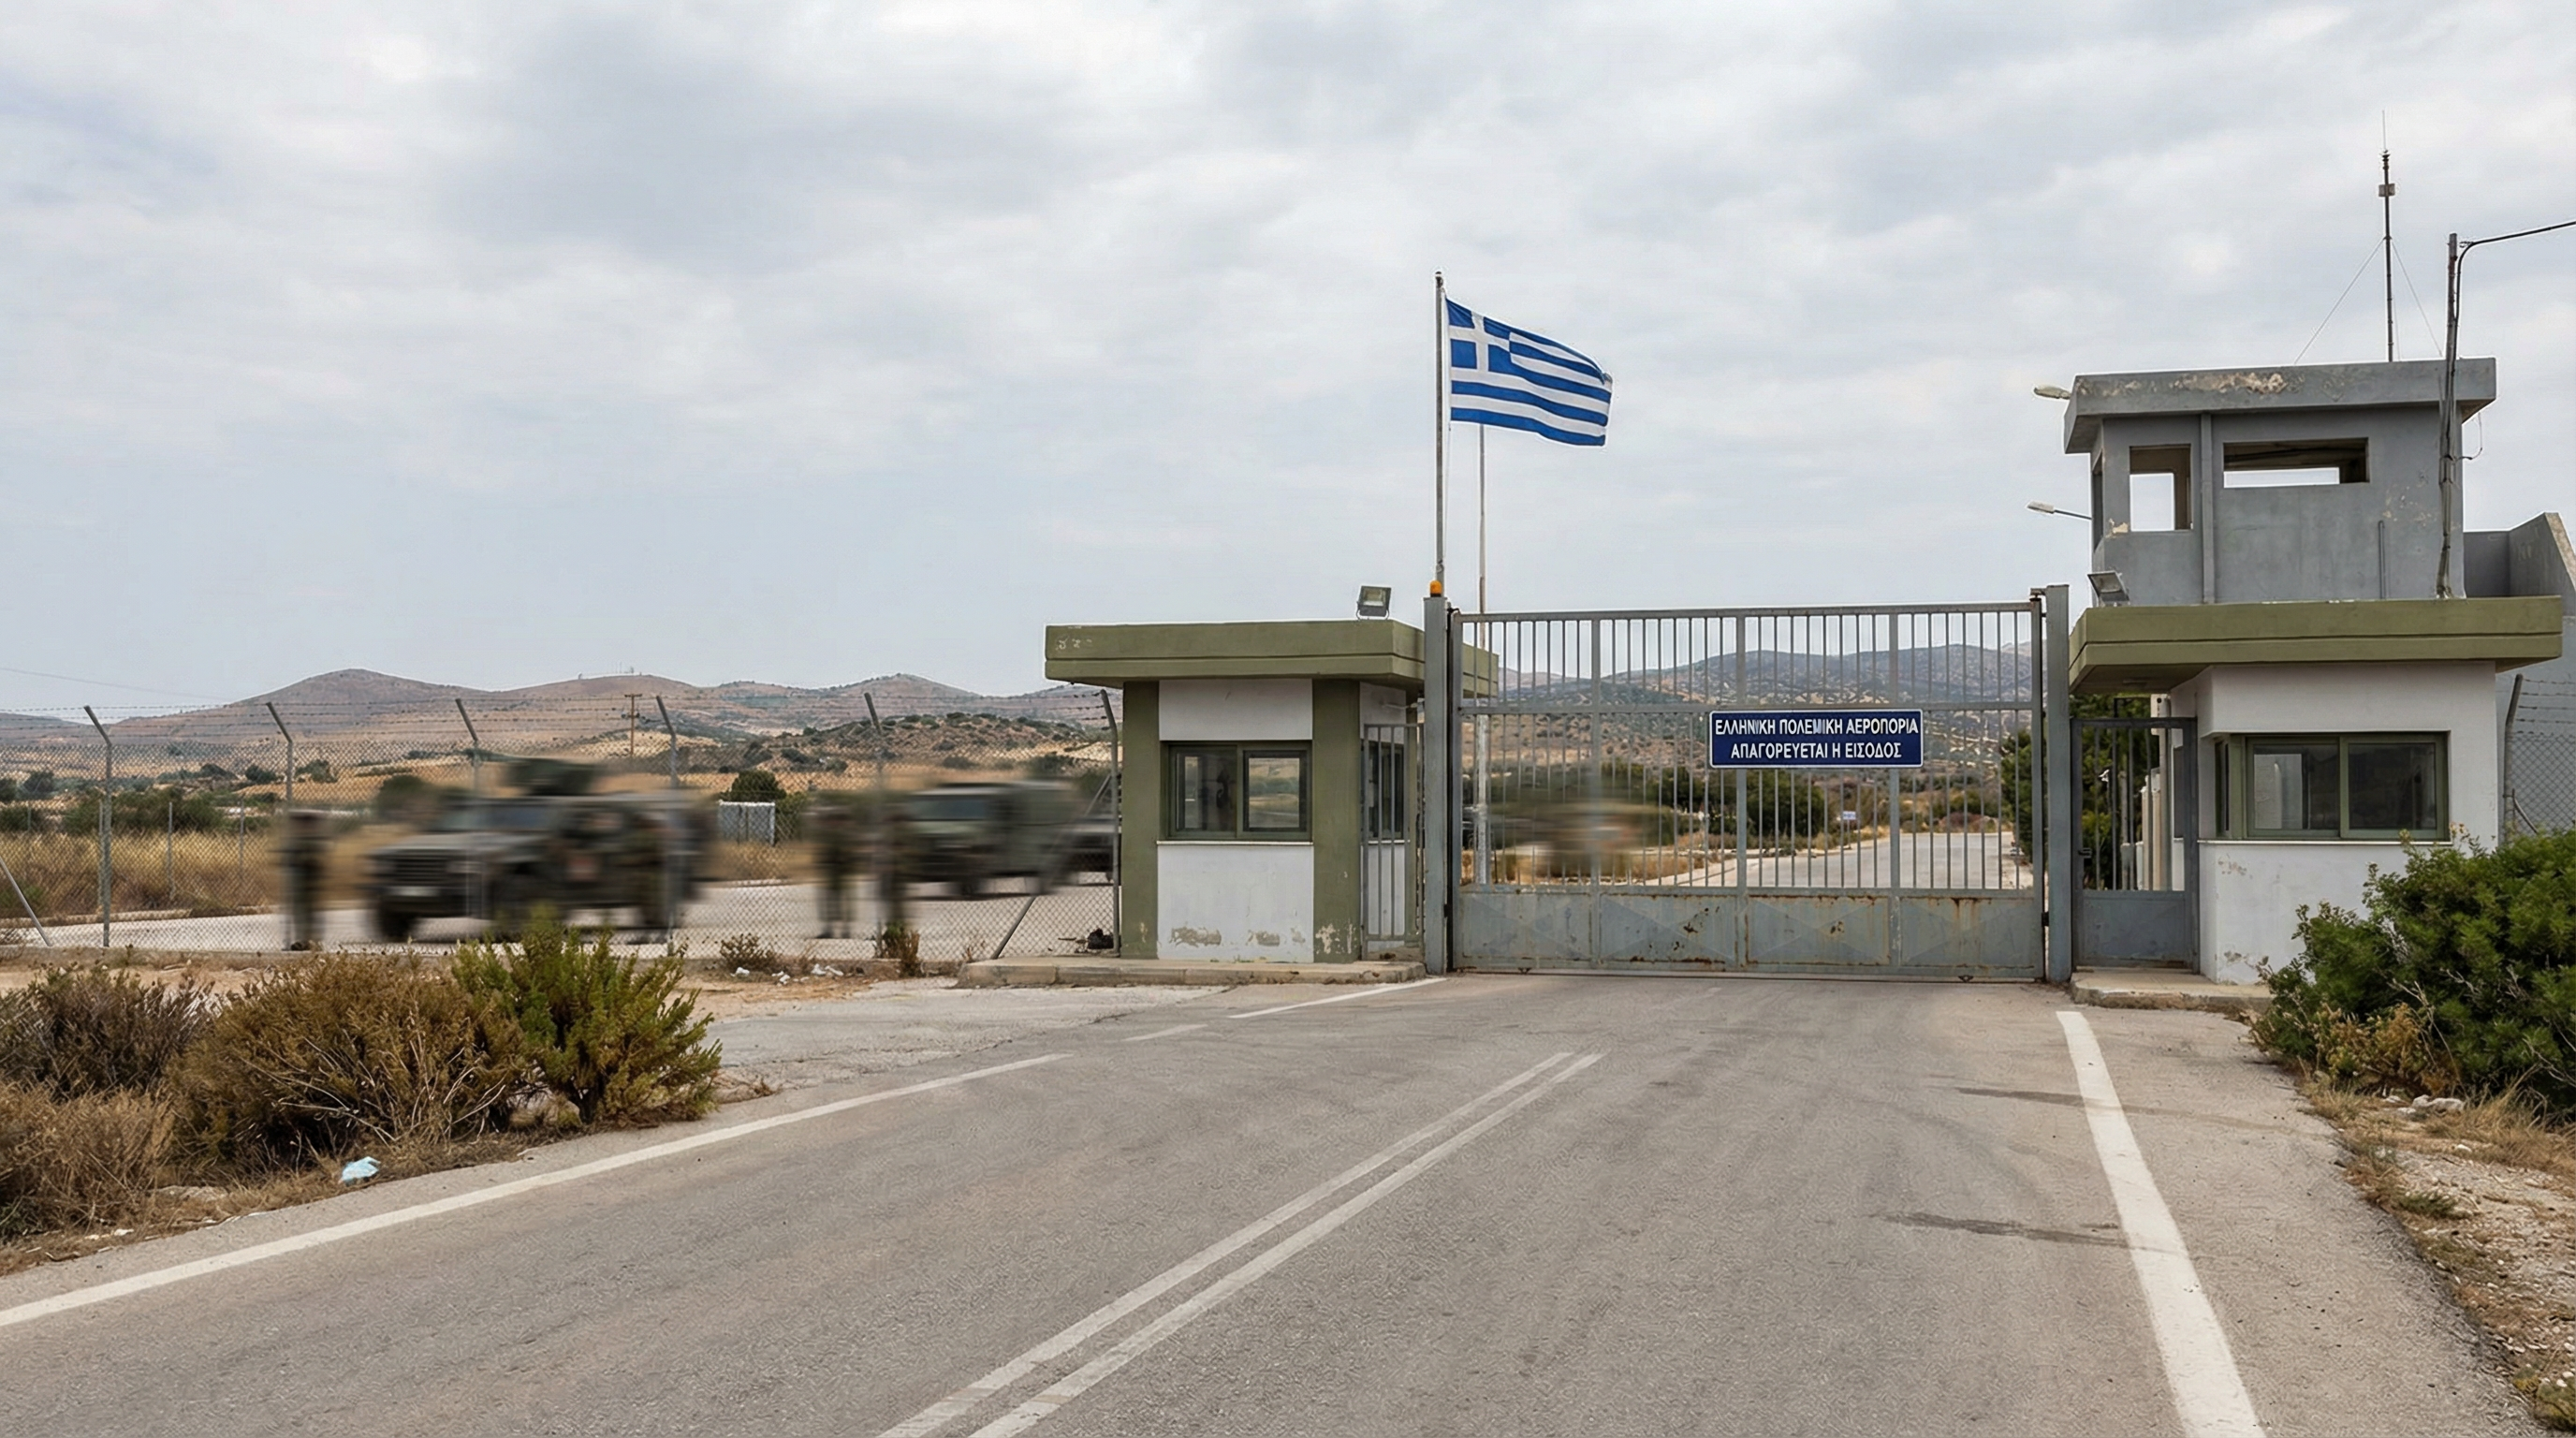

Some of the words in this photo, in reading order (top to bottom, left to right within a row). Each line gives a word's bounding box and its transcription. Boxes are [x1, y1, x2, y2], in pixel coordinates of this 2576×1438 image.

[1846, 718, 1919, 735] ΑΕΡΟΠΟΡΙΑ
[1731, 742, 1828, 759] ΑΠΑΓΟΡΕΥΕΤΑΙ
[1832, 742, 1841, 758] Η
[1845, 742, 1902, 758] ΕΙΣΟΔΟΣ
